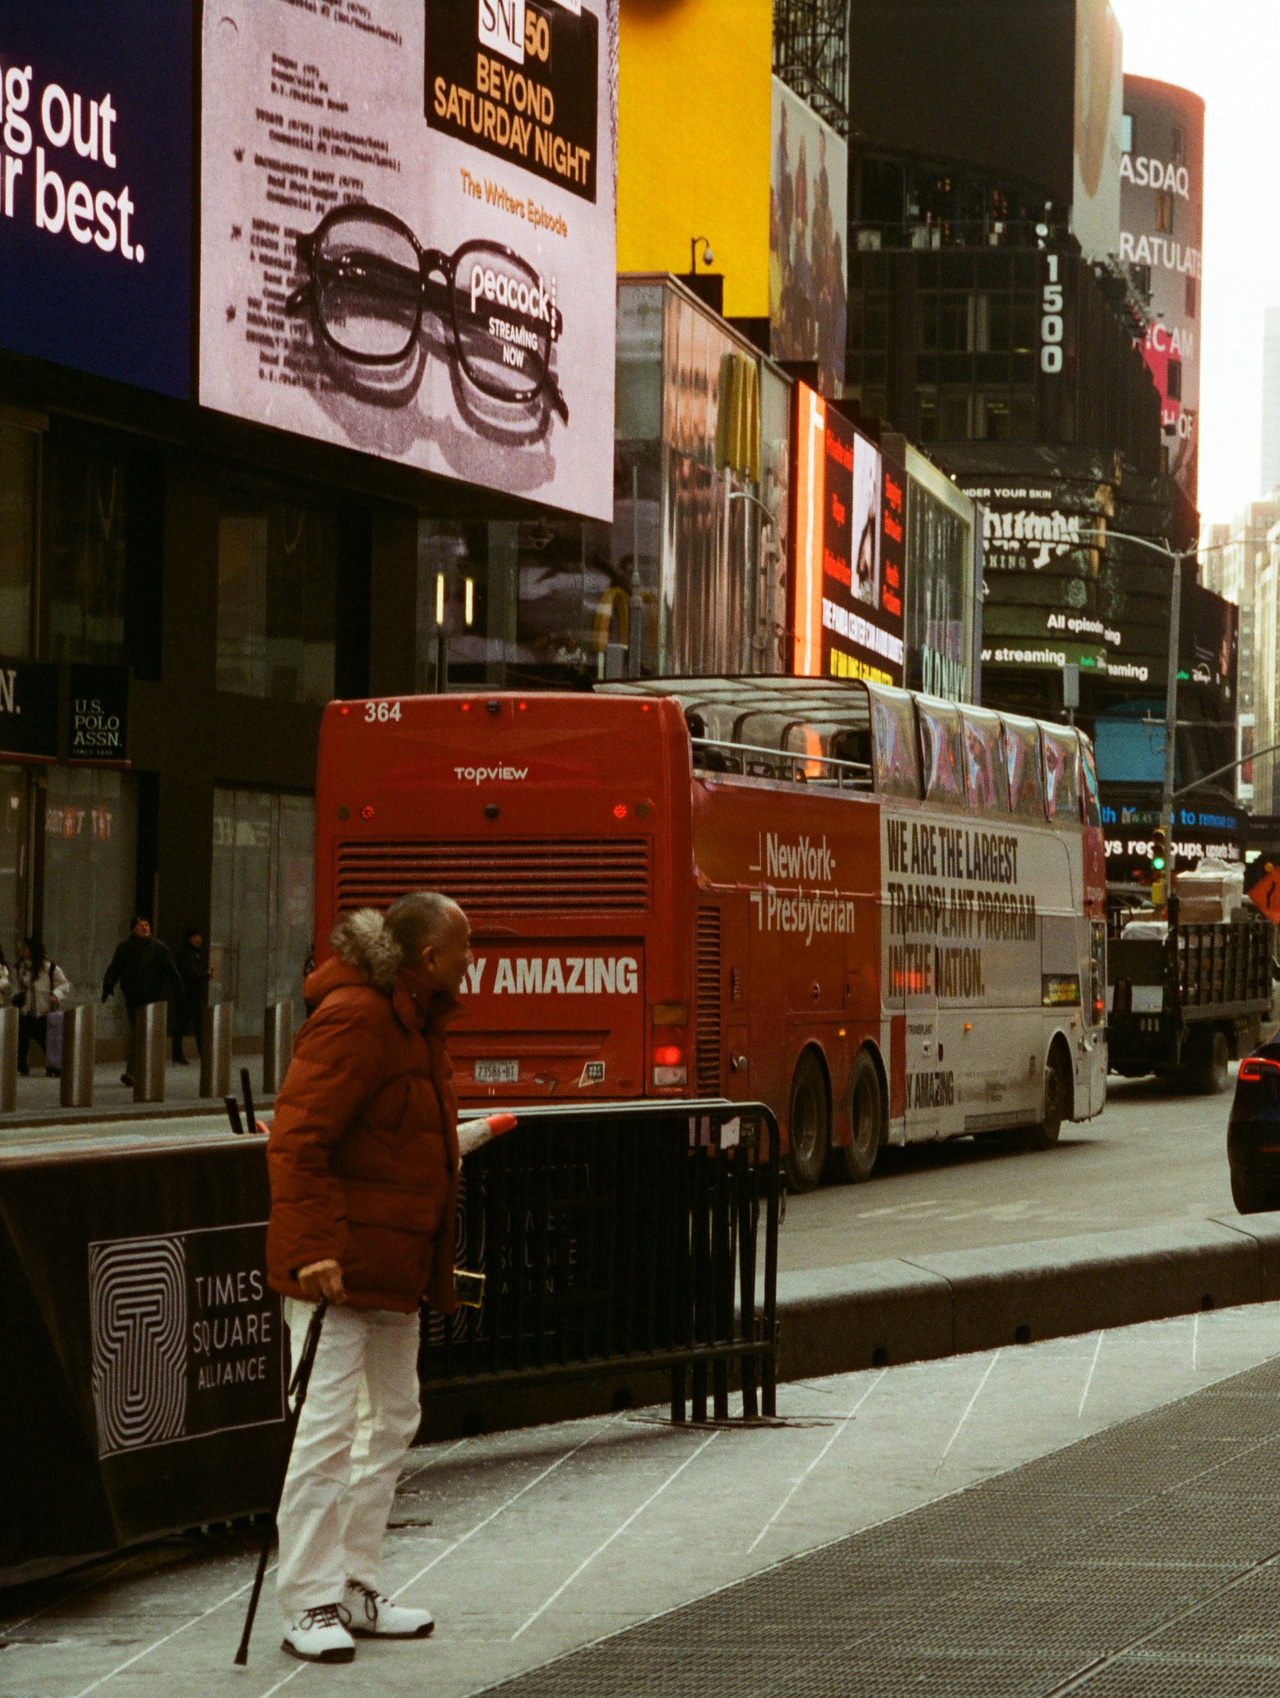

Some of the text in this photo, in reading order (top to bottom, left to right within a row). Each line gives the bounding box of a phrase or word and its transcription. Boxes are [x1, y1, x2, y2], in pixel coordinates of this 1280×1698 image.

[525, 9, 549, 63] 50
[477, 53, 555, 126] BEYOND
[42, 83, 117, 169] out
[434, 76, 532, 156] SATURDAY
[535, 126, 590, 186] NIGHT
[35, 145, 145, 263] best.
[460, 167, 568, 237] The Writers Episode
[471, 264, 549, 322] peacock
[1041, 254, 1063, 374] 1500
[489, 316, 538, 350] STREAMING
[503, 346, 524, 368] NOW
[994, 488, 1027, 499] YOUR
[1029, 489, 1052, 499] SKIN
[1047, 614, 1065, 630] All
[995, 649, 1066, 666] streaming
[75, 699, 105, 714] U.S.
[75, 714, 120, 730] POLO
[364, 702, 401, 723] 364
[73, 731, 122, 747] ASSN.
[1180, 809, 1196, 825] to
[887, 819, 1018, 884] WE ARE THE LARGEST
[767, 885, 855, 947] Presbyterian
[887, 882, 1036, 941] TRANSPLANT PROGRAM
[493, 957, 638, 994] AMAZING
[888, 943, 985, 997] IN THE NATION.
[195, 1269, 263, 1308] TIMES
[192, 1311, 271, 1357] SQUARE
[198, 1356, 267, 1390] ALLIANCE
